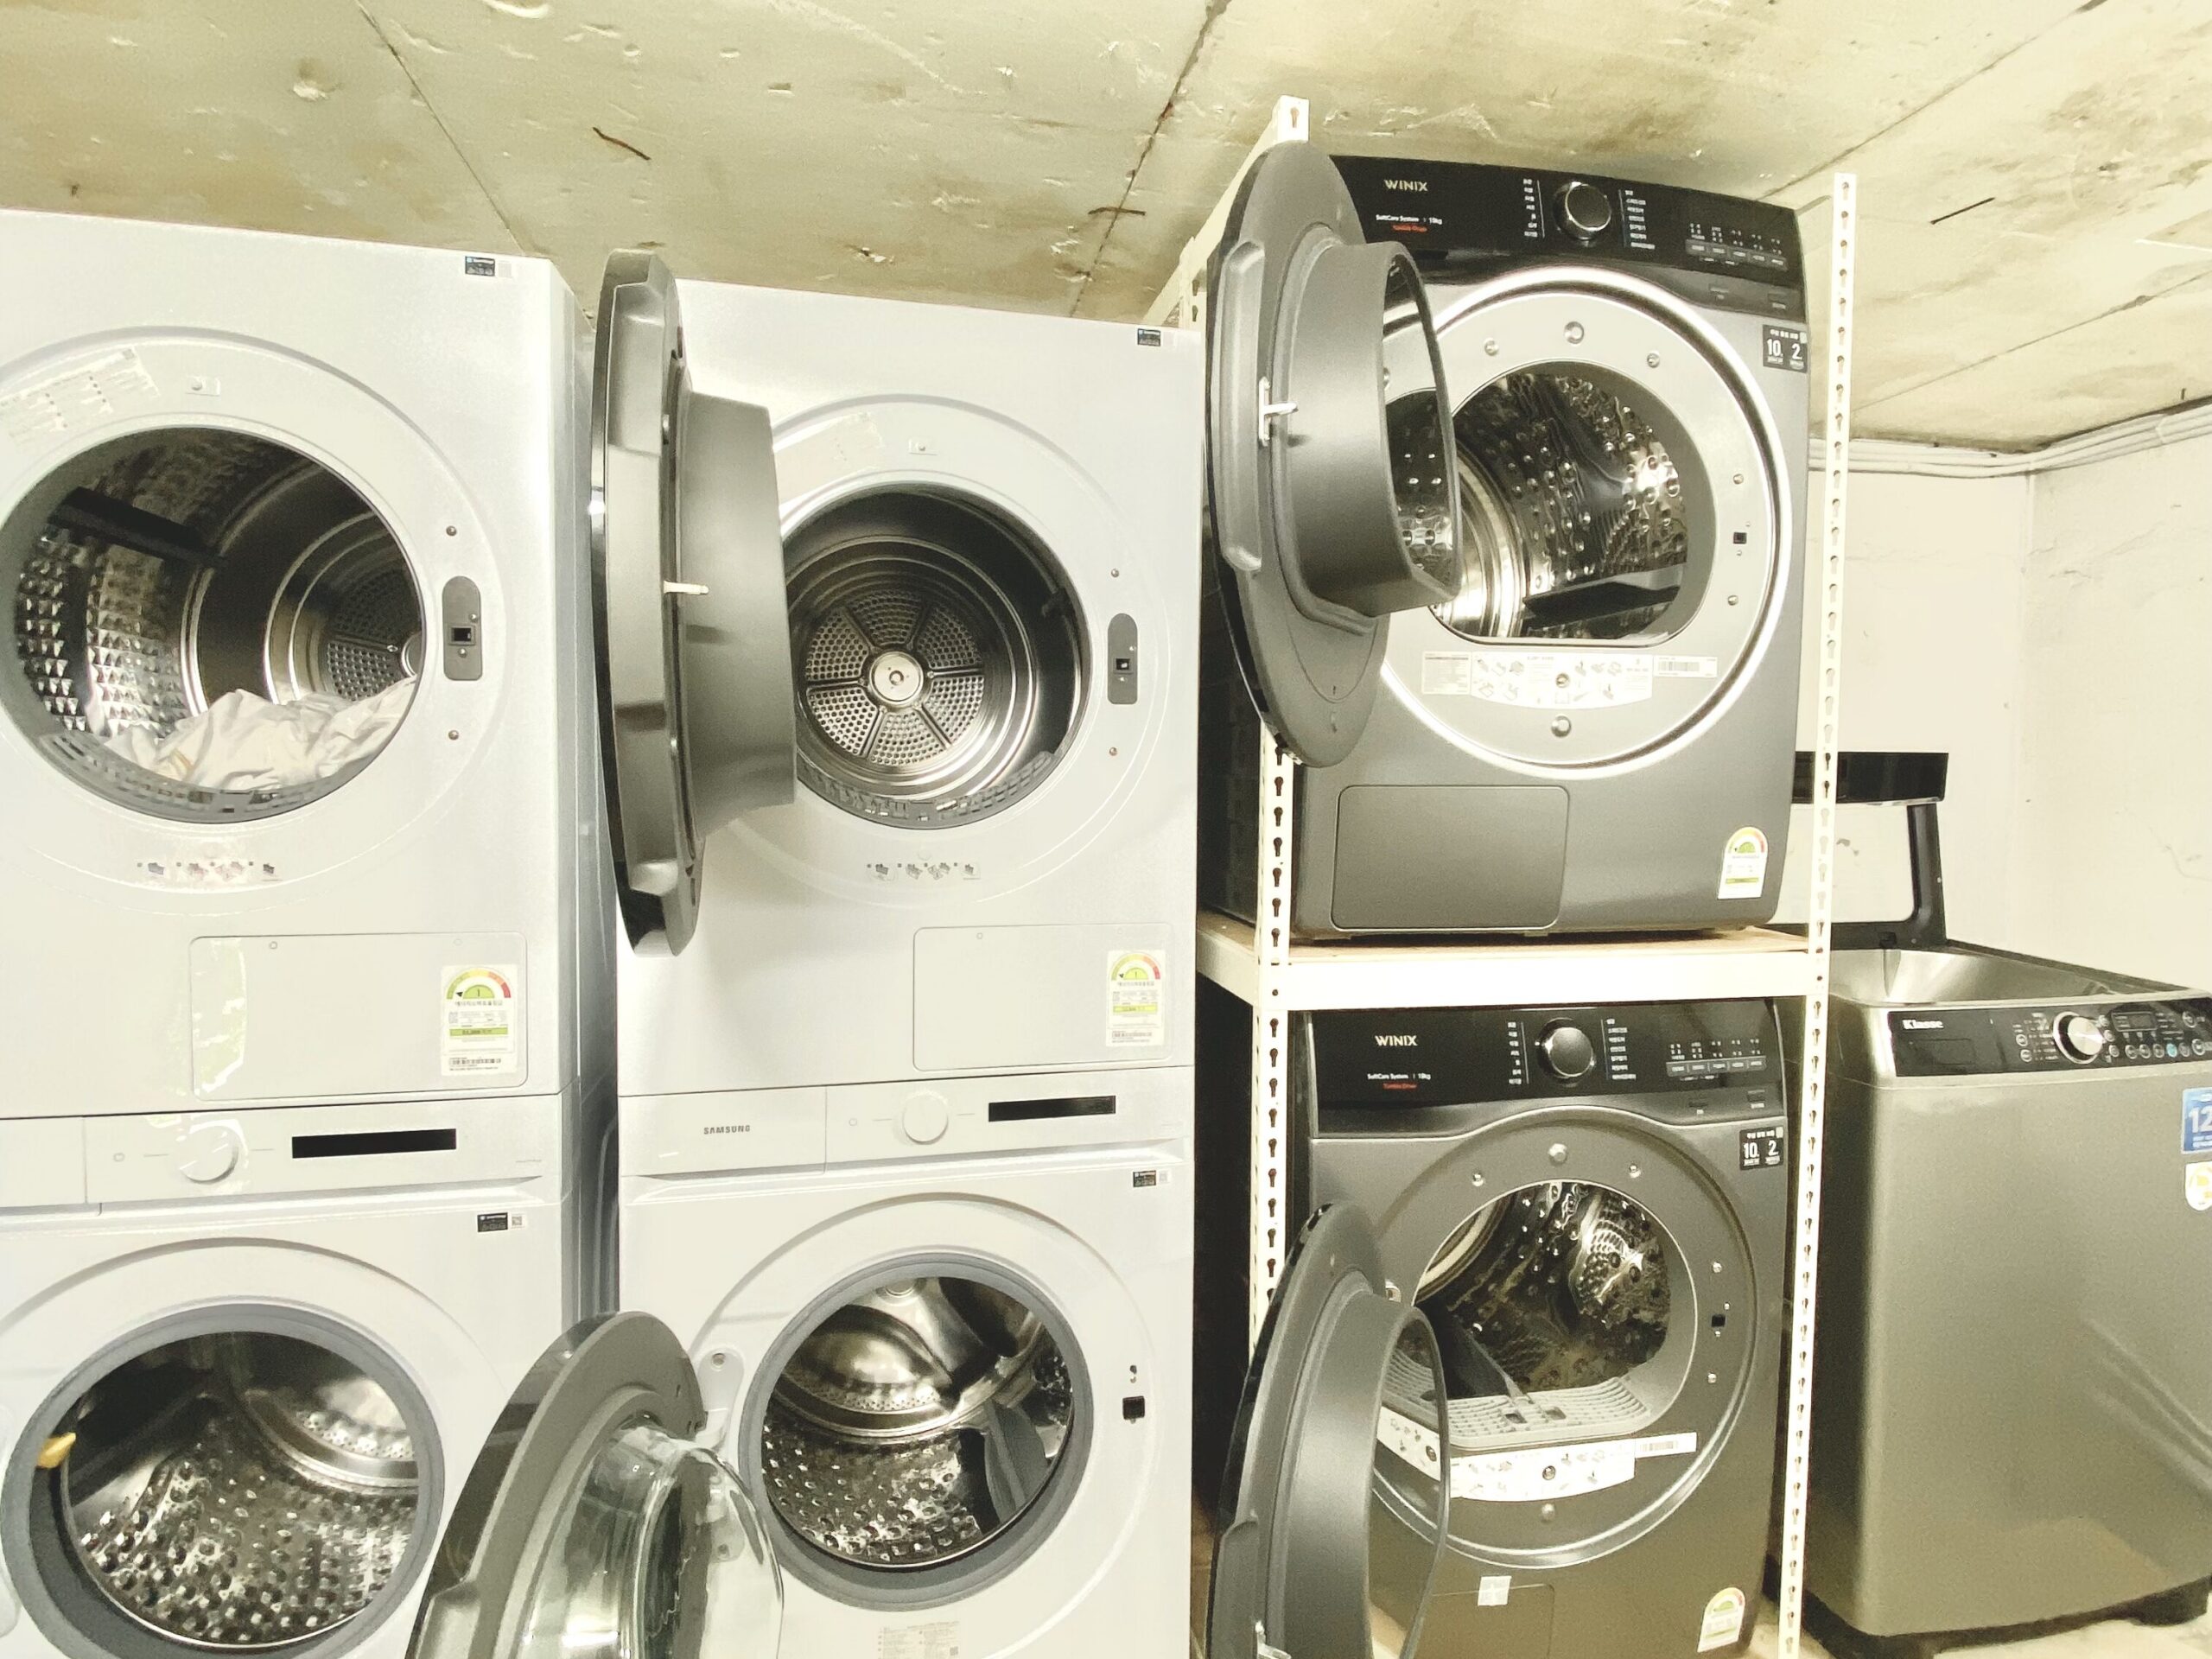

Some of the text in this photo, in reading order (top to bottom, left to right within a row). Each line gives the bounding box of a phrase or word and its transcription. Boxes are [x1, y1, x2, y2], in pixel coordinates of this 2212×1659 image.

[1383, 180, 1428, 191] WINIX
[1375, 1035, 1418, 1046] WINIX
[703, 1125, 751, 1135] SAMSUNG
